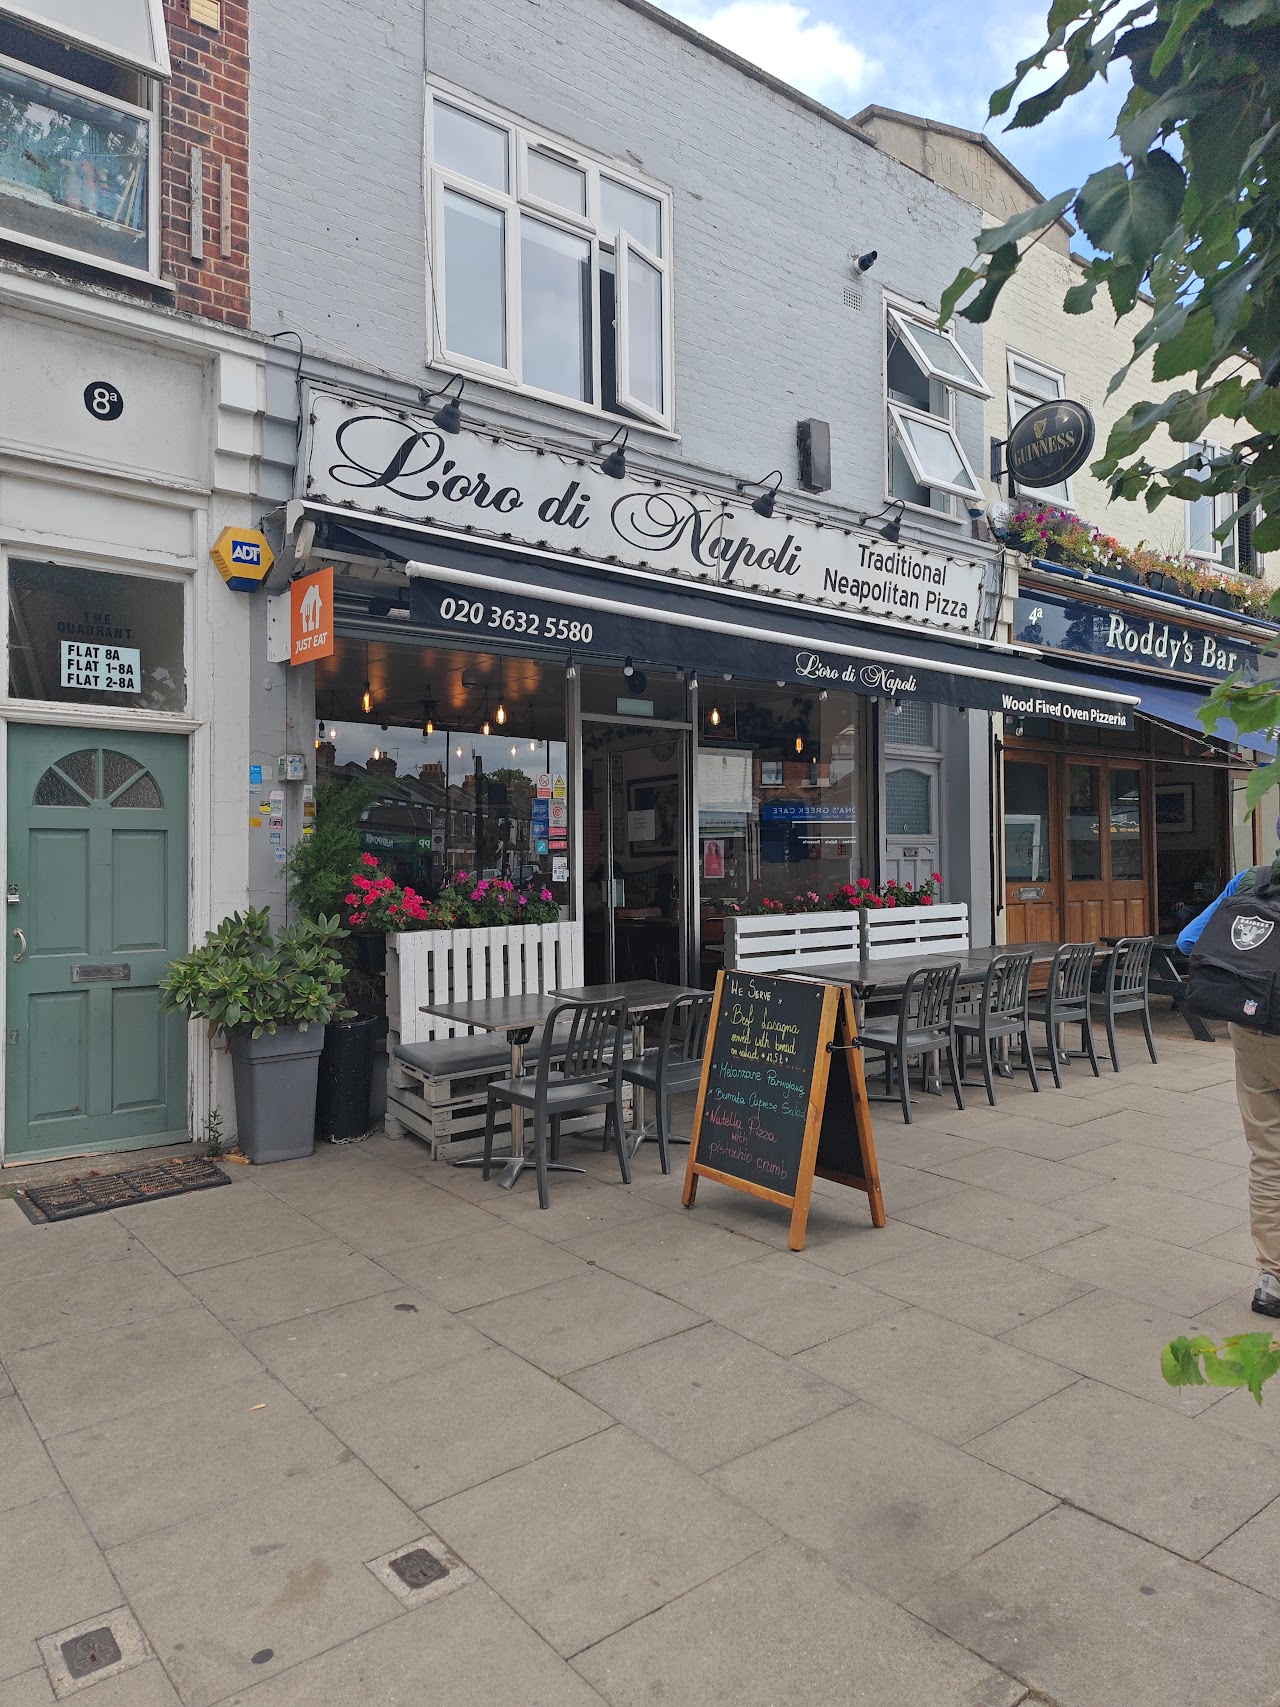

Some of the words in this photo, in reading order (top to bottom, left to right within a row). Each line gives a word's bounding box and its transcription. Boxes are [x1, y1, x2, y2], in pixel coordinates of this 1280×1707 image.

[92, 388, 117, 414] 8a
[1014, 430, 1075, 467] GUINNESS
[328, 415, 523, 513] L'oro
[537, 481, 591, 529] di
[610, 492, 802, 579] Napoli
[232, 545, 260, 562] ADT
[858, 543, 947, 586] Traditional
[823, 568, 919, 608] Neapolitan
[925, 590, 968, 619] Pizza
[440, 598, 484, 624] 020
[488, 606, 540, 635] 3632
[543, 617, 593, 643] 5580
[1028, 606, 1043, 625] 4a
[57, 622, 132, 640] QUADRANT
[295, 636, 312, 654] JUST
[313, 632, 328, 647] EAT
[1106, 613, 1193, 668] Roddy's
[1201, 635, 1238, 672] Bar
[67, 645, 100, 659] FLAT
[105, 649, 120, 661] 8A
[67, 659, 100, 672] FLAT
[105, 662, 134, 675] 1-8A
[67, 673, 100, 687] FLAT
[105, 676, 134, 689] 2-8A
[795, 651, 839, 679] L'oro
[842, 665, 857, 682] di
[860, 664, 917, 695] Napoli
[1002, 694, 1033, 712] Wood
[1035, 699, 1061, 716] Fired
[1063, 705, 1089, 721] Oven
[1090, 708, 1126, 726] Pizzeria
[1239, 917, 1270, 928] RAIDERS
[739, 1045, 759, 1060] salad
[755, 1031, 770, 1048] with
[714, 1087, 746, 1105] Burrata
[782, 1102, 807, 1121] Salad
[710, 1105, 743, 1129] Nutella
[748, 1116, 777, 1143] Pizza
[709, 1142, 753, 1163] pistachio
[756, 1158, 788, 1179] crumb
